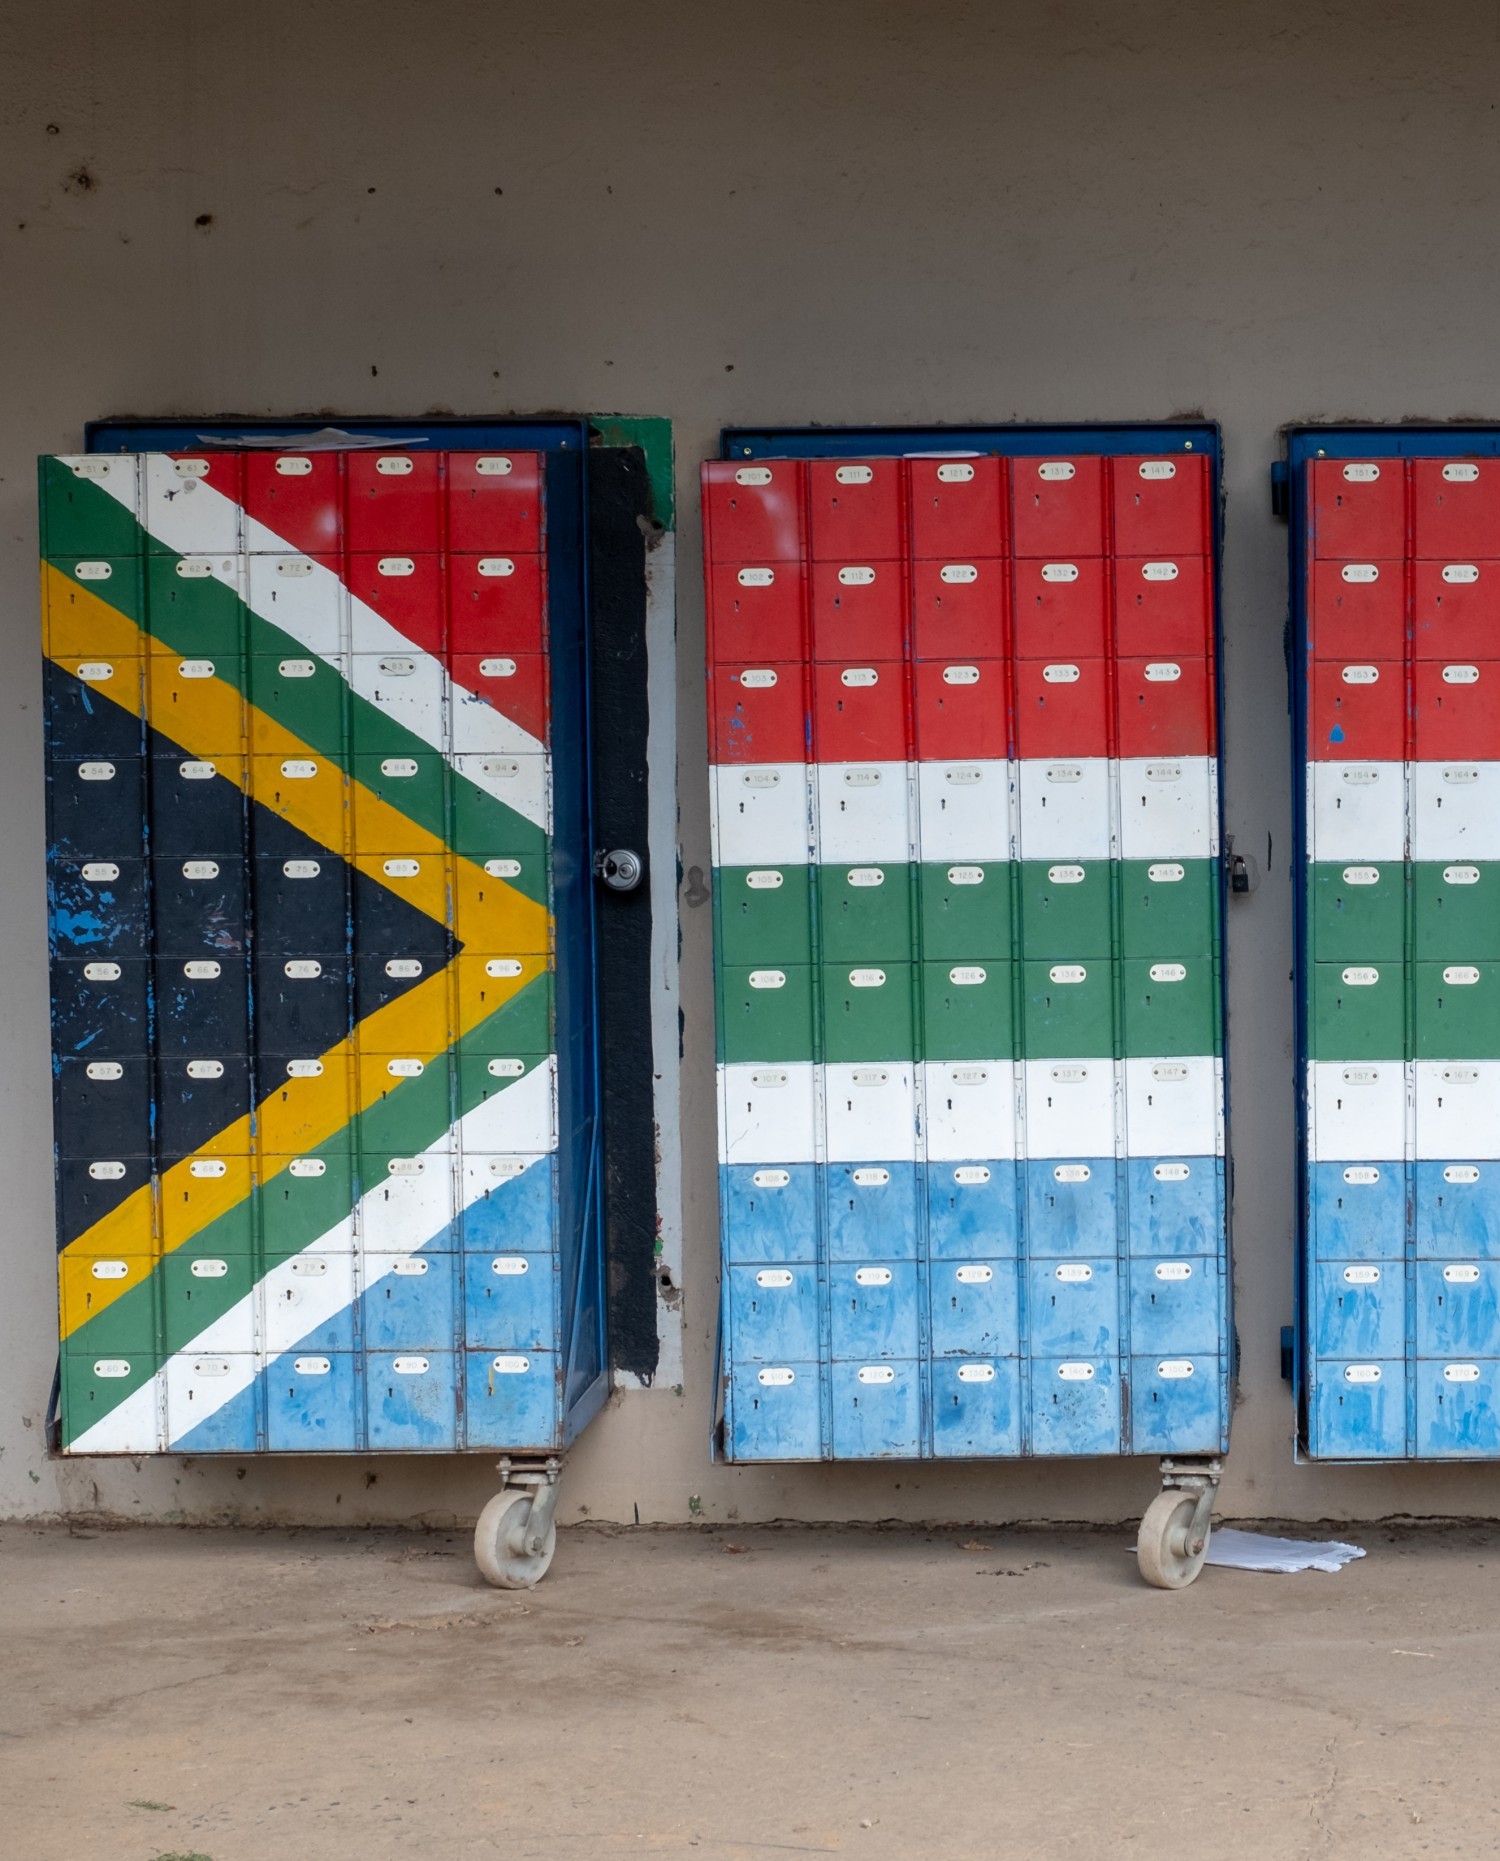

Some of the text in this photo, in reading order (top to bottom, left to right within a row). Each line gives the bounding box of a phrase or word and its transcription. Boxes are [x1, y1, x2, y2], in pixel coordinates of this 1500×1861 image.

[86, 464, 96, 473] 51
[186, 464, 196, 472] 61
[389, 461, 399, 470] 81
[488, 462, 499, 470] 91
[1150, 465, 1164, 474] 141
[848, 470, 860, 478] 111
[949, 468, 962, 477] 121
[1050, 466, 1064, 475] 131
[1354, 468, 1368, 476] 151
[1454, 468, 1467, 476] 161
[87, 566, 99, 574] 52
[188, 564, 200, 572] 62
[289, 563, 300, 572] 72
[390, 562, 402, 570] 82
[490, 563, 502, 571] 92
[951, 570, 967, 578] 122
[1052, 568, 1068, 576] 132
[1152, 567, 1168, 576] 142
[89, 667, 101, 675] 53
[190, 664, 203, 673] 63
[291, 664, 303, 672] 73
[491, 663, 504, 671] 93
[853, 673, 866, 681] 113
[953, 670, 969, 679] 123
[1054, 669, 1069, 677] 133
[1352, 670, 1368, 678] 153
[1453, 670, 1468, 678] 163
[91, 767, 103, 775] 54
[191, 766, 204, 774] 64
[393, 763, 406, 771] 84
[494, 763, 507, 771] 94
[1057, 769, 1072, 777] 134
[1353, 771, 1369, 779] 154
[1454, 770, 1469, 778] 164
[194, 866, 206, 874] 65
[296, 865, 308, 873] 75
[395, 863, 407, 871] 85
[496, 864, 509, 872] 95
[958, 871, 974, 879] 125
[1059, 869, 1074, 878] 135
[1158, 868, 1174, 876] 145
[1353, 871, 1369, 879] 155
[1454, 871, 1469, 879] 165
[96, 967, 108, 975] 56
[298, 965, 309, 973] 76
[398, 964, 410, 972] 86
[1160, 968, 1176, 976] 146
[1061, 970, 1076, 978] 136
[1353, 971, 1368, 980] 156
[99, 1067, 111, 1075] 57
[199, 1065, 212, 1073] 67
[500, 1063, 512, 1071] 97
[1163, 1067, 1178, 1075] 147
[962, 1071, 977, 1080] 127
[1353, 1072, 1368, 1080] 157
[501, 1163, 513, 1171] 98
[1354, 1171, 1369, 1179] 158
[202, 1263, 215, 1272] 69
[404, 1262, 416, 1270] 89
